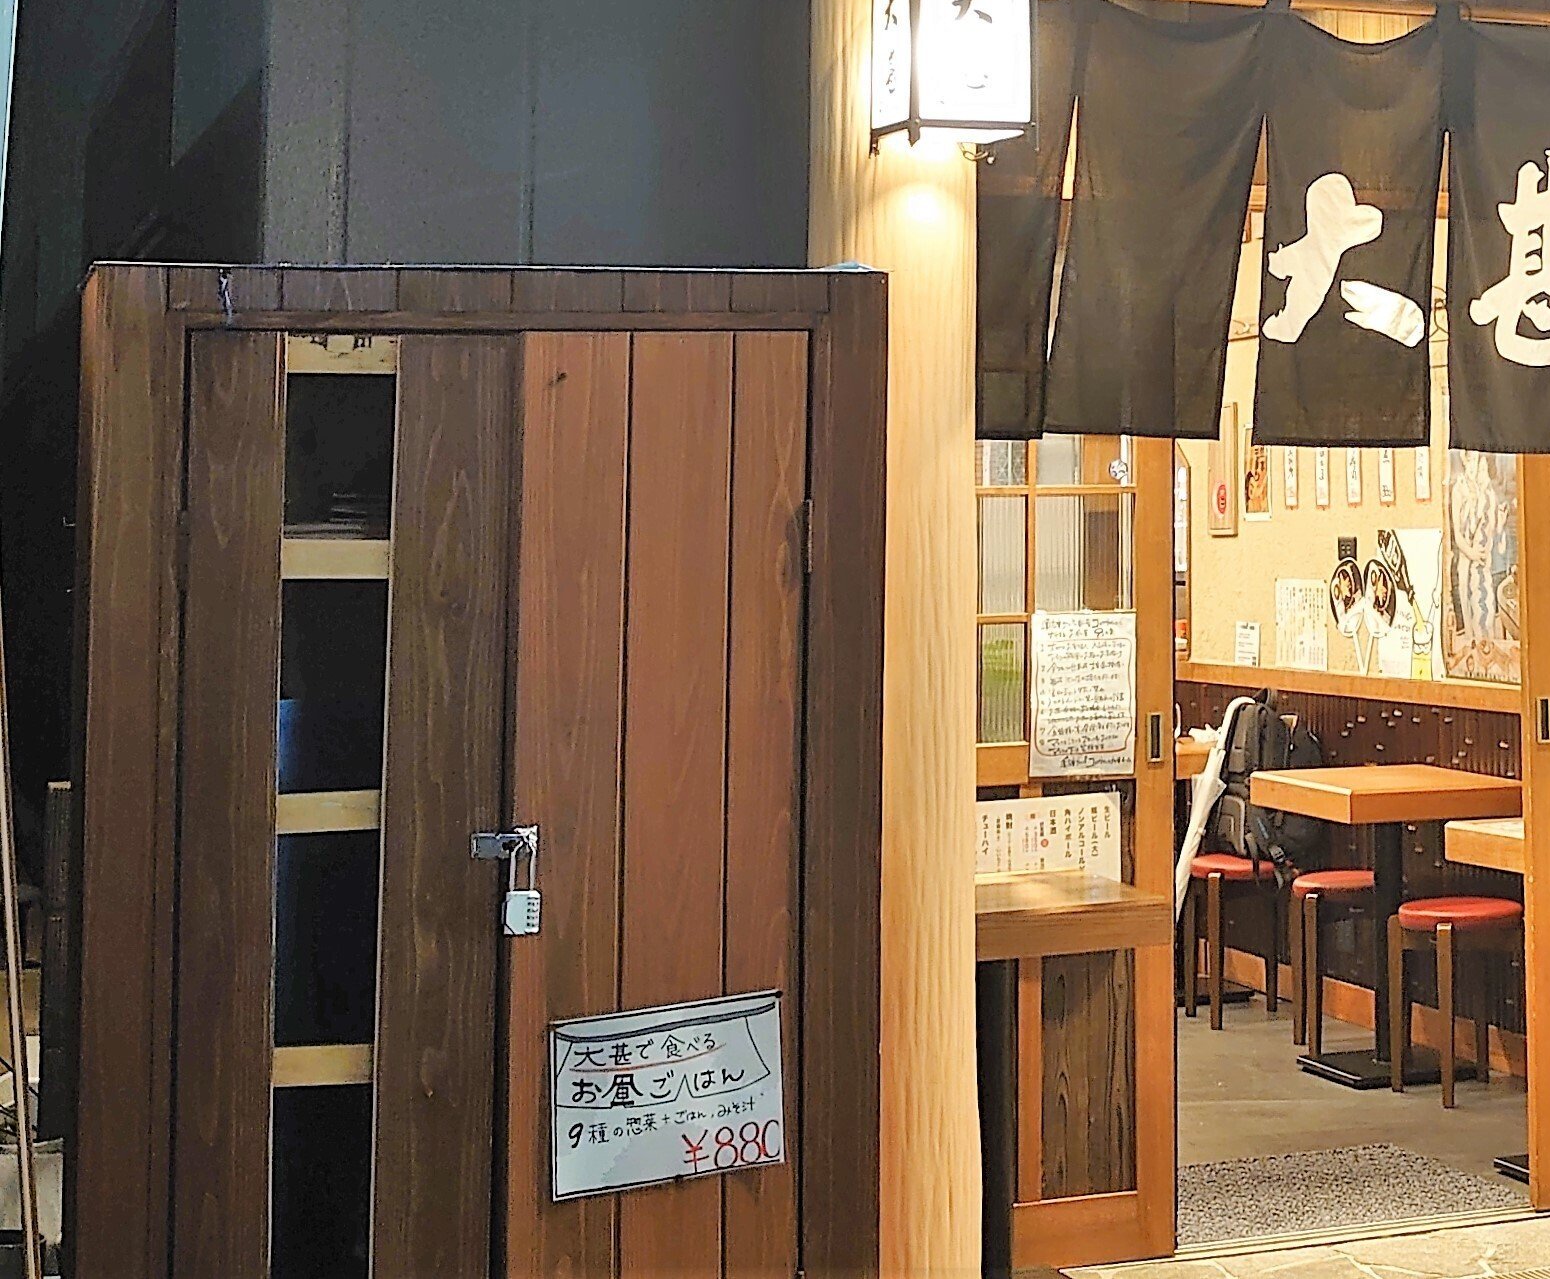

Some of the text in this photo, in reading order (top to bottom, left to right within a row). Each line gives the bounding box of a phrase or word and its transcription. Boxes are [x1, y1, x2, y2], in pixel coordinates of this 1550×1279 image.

[981, 814, 990, 856] チューハイ
[1049, 809, 1057, 835] 日本酒
[570, 1069, 746, 1108] お昼ごはん
[681, 1119, 781, 1174] ¥880
